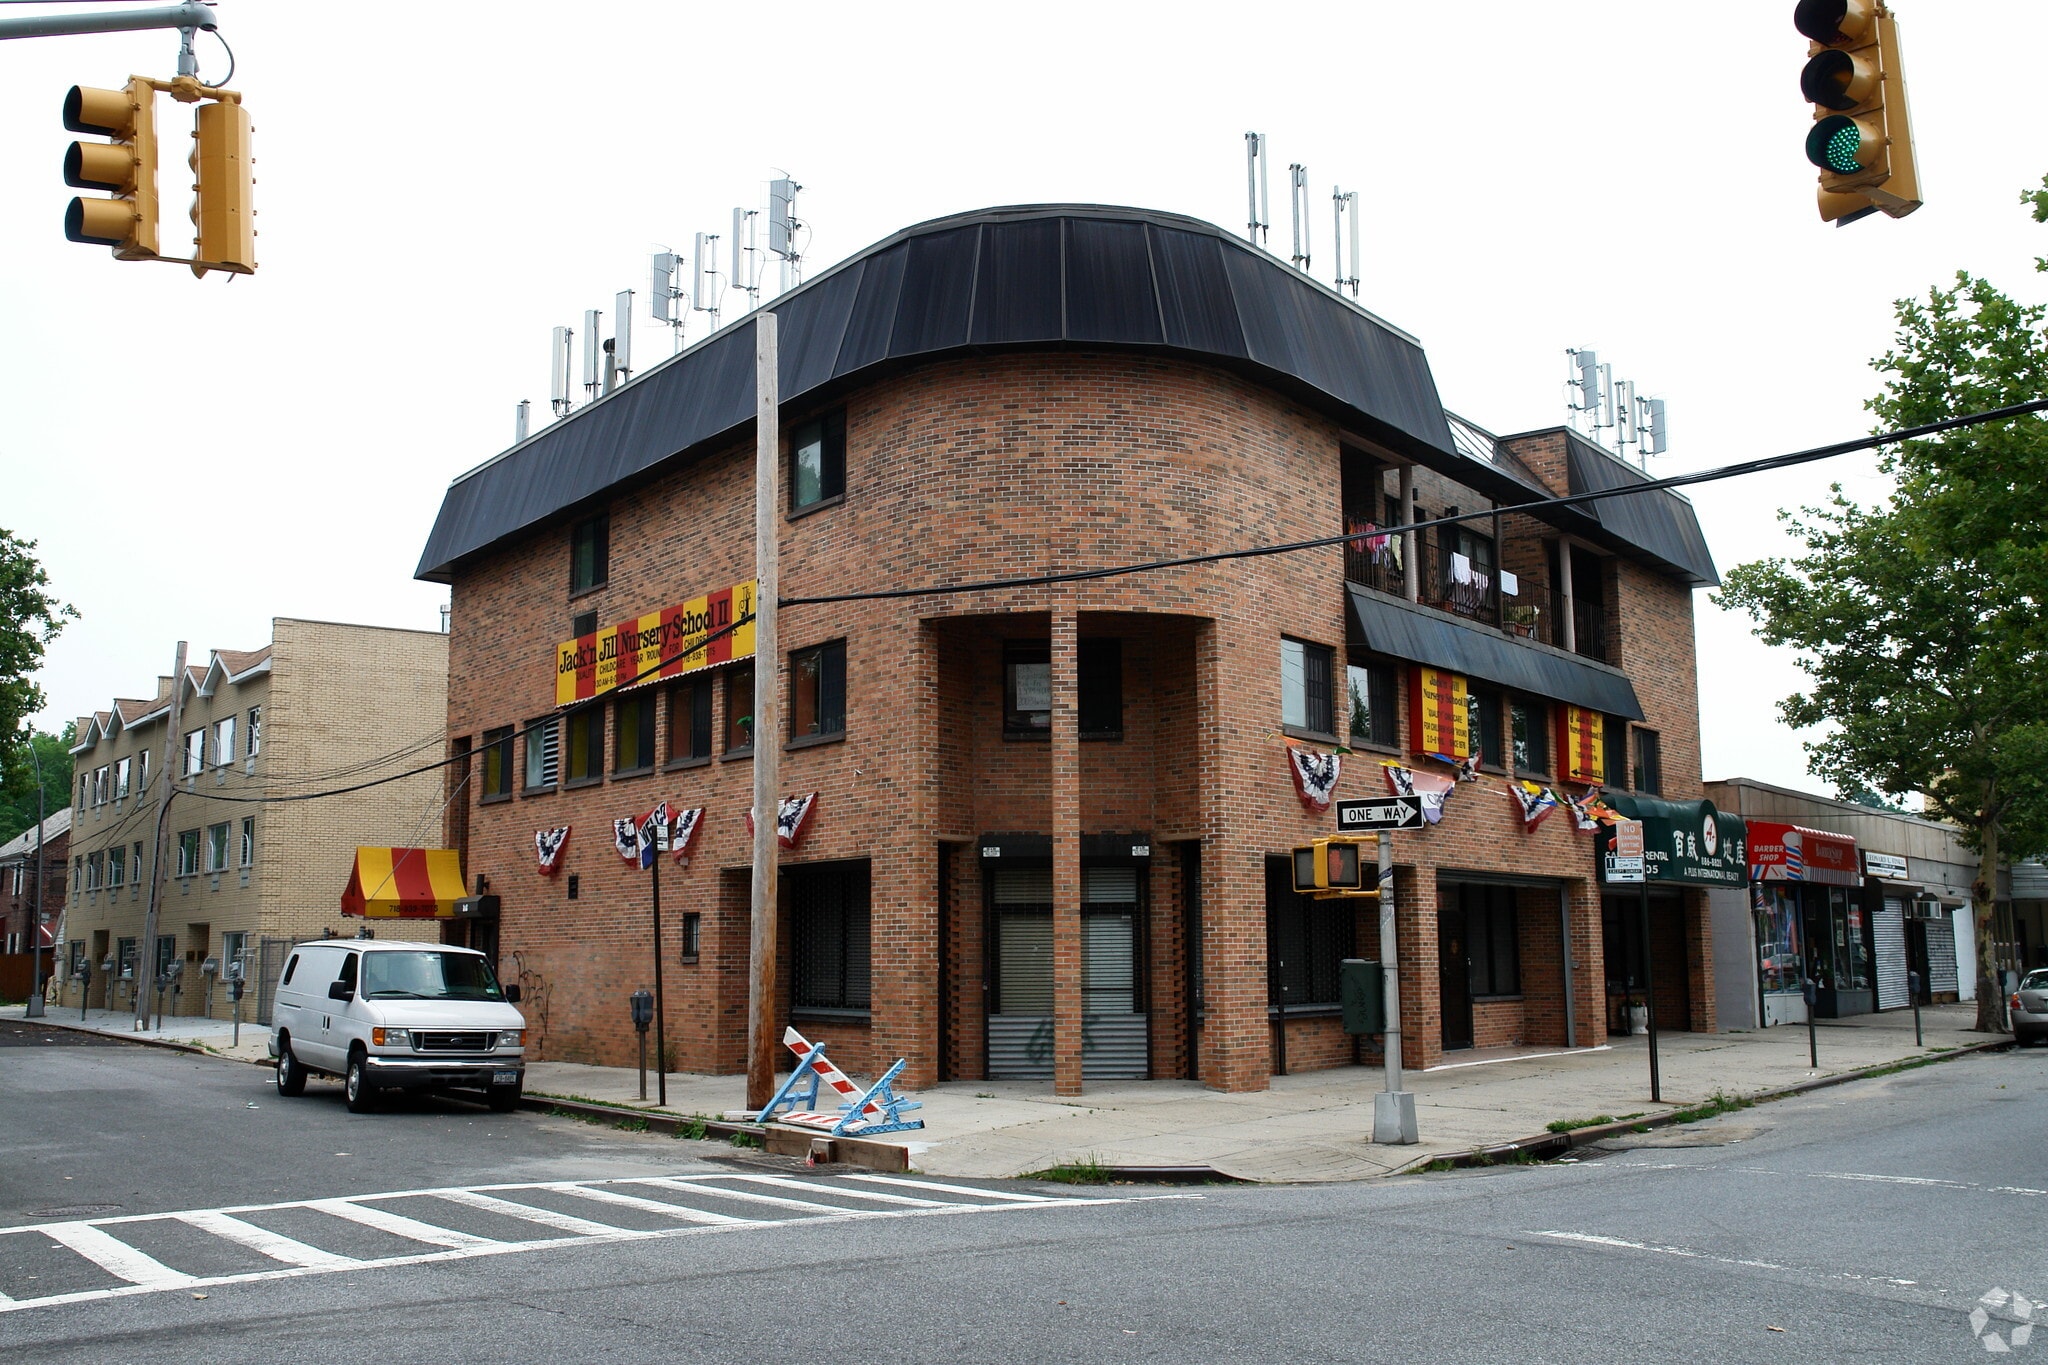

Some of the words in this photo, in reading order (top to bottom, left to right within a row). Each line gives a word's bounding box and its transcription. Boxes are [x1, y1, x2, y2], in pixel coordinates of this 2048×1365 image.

[560, 643, 597, 674] Jack'n
[599, 634, 618, 662] Jill
[620, 623, 673, 656] Nursery
[672, 603, 715, 639] School
[717, 598, 729, 626] II
[630, 653, 644, 666] YEAR
[668, 642, 679, 654] FOR
[1349, 808, 1373, 822] ONE
[1383, 806, 1408, 820] WAY
[1623, 825, 1636, 833] NO
[1754, 844, 1785, 853] BARBER
[1759, 853, 1780, 862] SHOP
[1683, 866, 1688, 876] A
[1688, 867, 1698, 877] PLUS
[1698, 868, 1726, 880] INTERNATIONAL
[1726, 871, 1740, 881] REALTY
